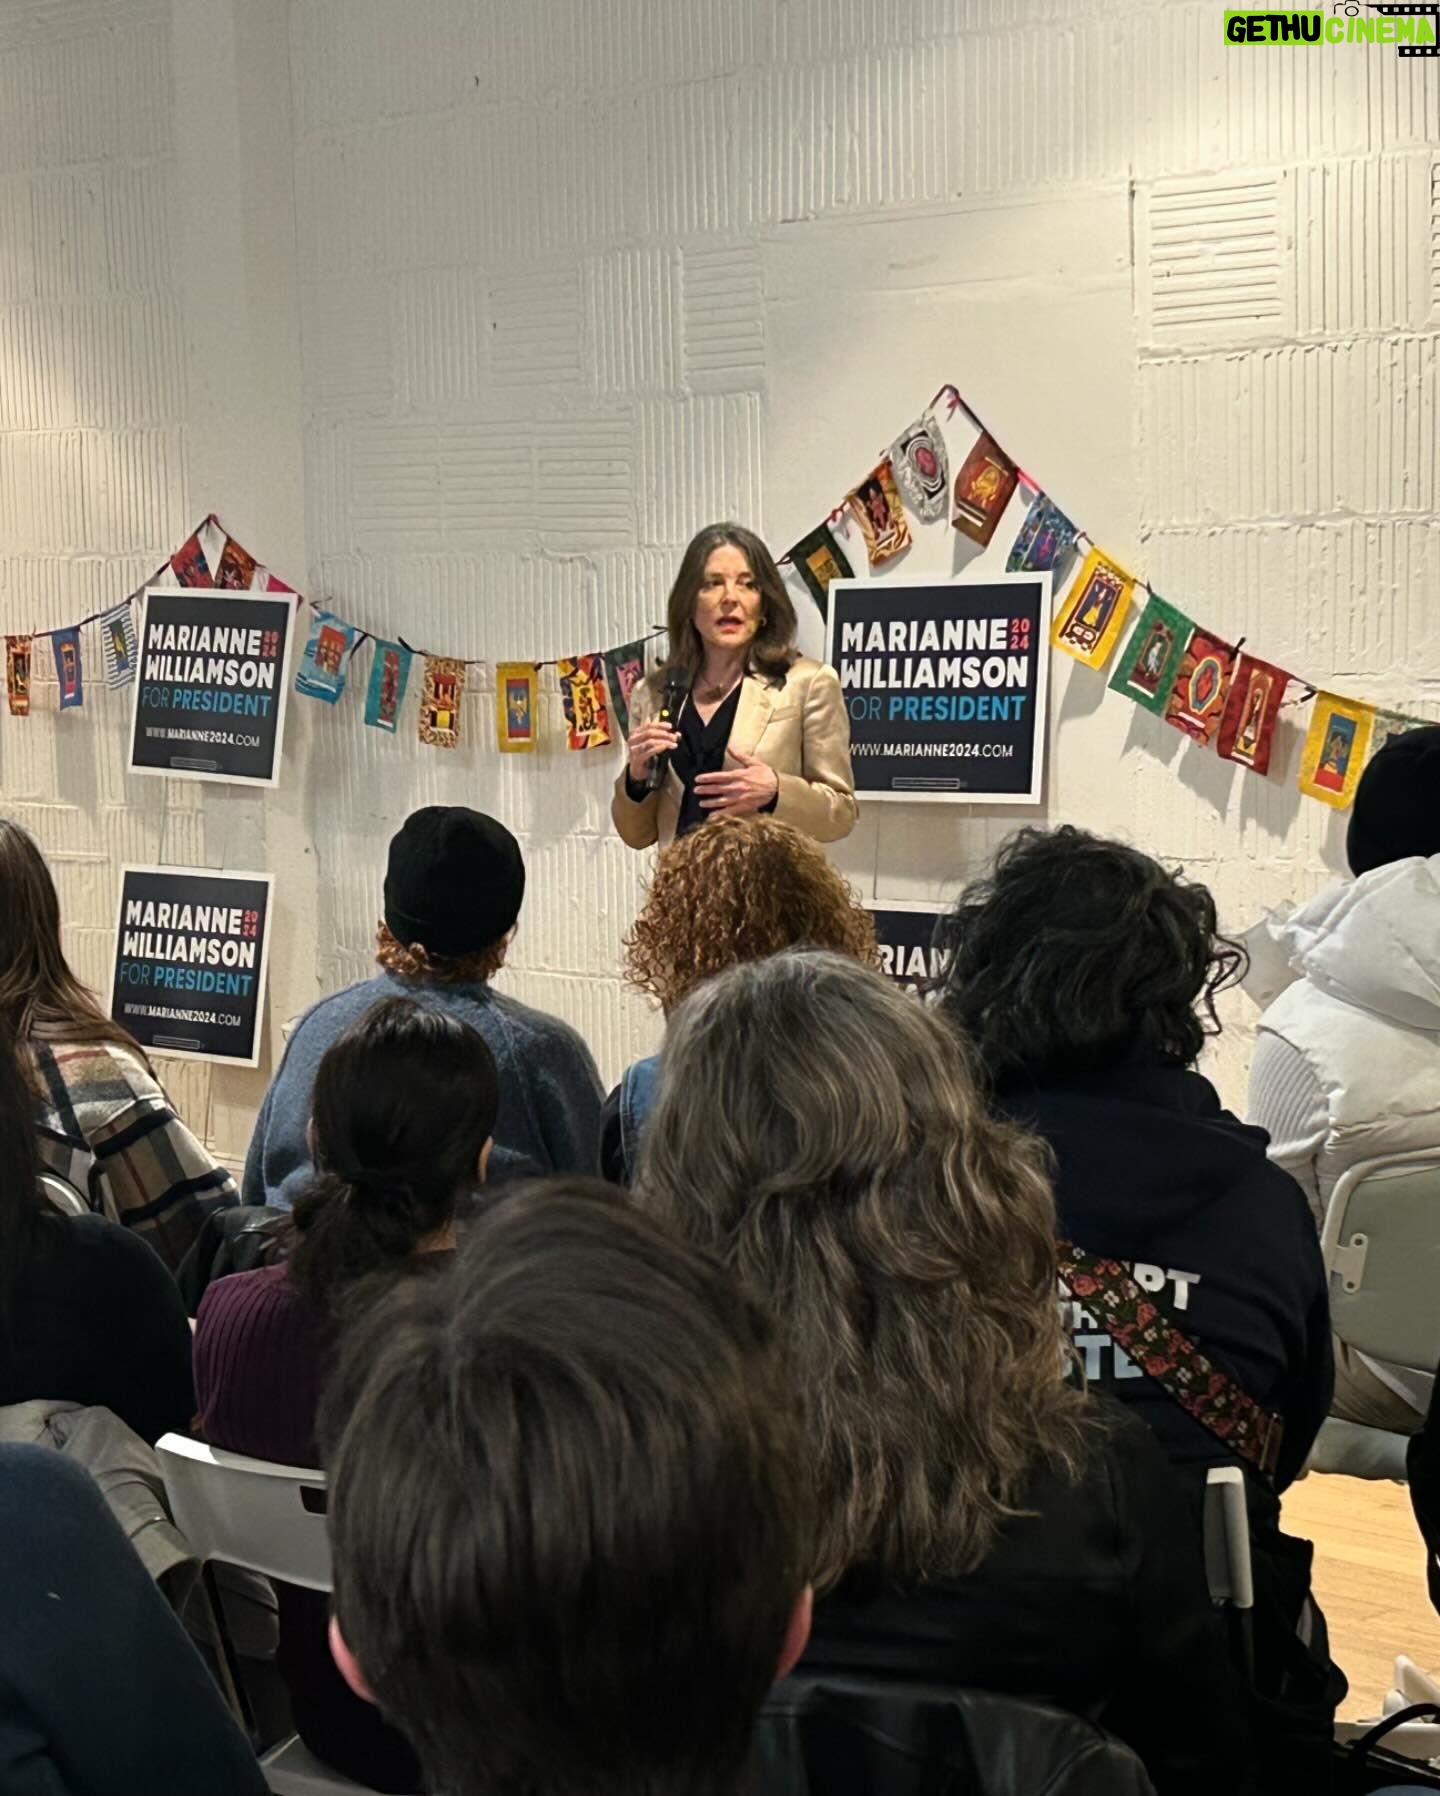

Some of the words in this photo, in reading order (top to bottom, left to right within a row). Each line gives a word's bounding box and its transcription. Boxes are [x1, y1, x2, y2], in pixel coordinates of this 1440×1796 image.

[148, 623, 262, 656] MARIANNE
[265, 631, 279, 643] 20
[841, 619, 1008, 652] MARIANNE
[1011, 618, 1030, 633] 20
[262, 645, 277, 657] 24
[1010, 635, 1029, 650] 24
[144, 654, 275, 689] WILLIAMSON
[840, 656, 1029, 688] WILLIAMSON
[142, 686, 170, 709] FOR
[172, 688, 272, 718] PRESIDENT
[844, 695, 881, 720] OR
[888, 695, 1026, 721] PRESIDENT
[125, 900, 243, 936] MARIANNE
[244, 910, 259, 923] 20
[122, 931, 256, 968] WILLIAMSON
[877, 944, 951, 978] RIAN
[119, 962, 150, 986] FOR
[153, 966, 253, 997] PRESIDENT
